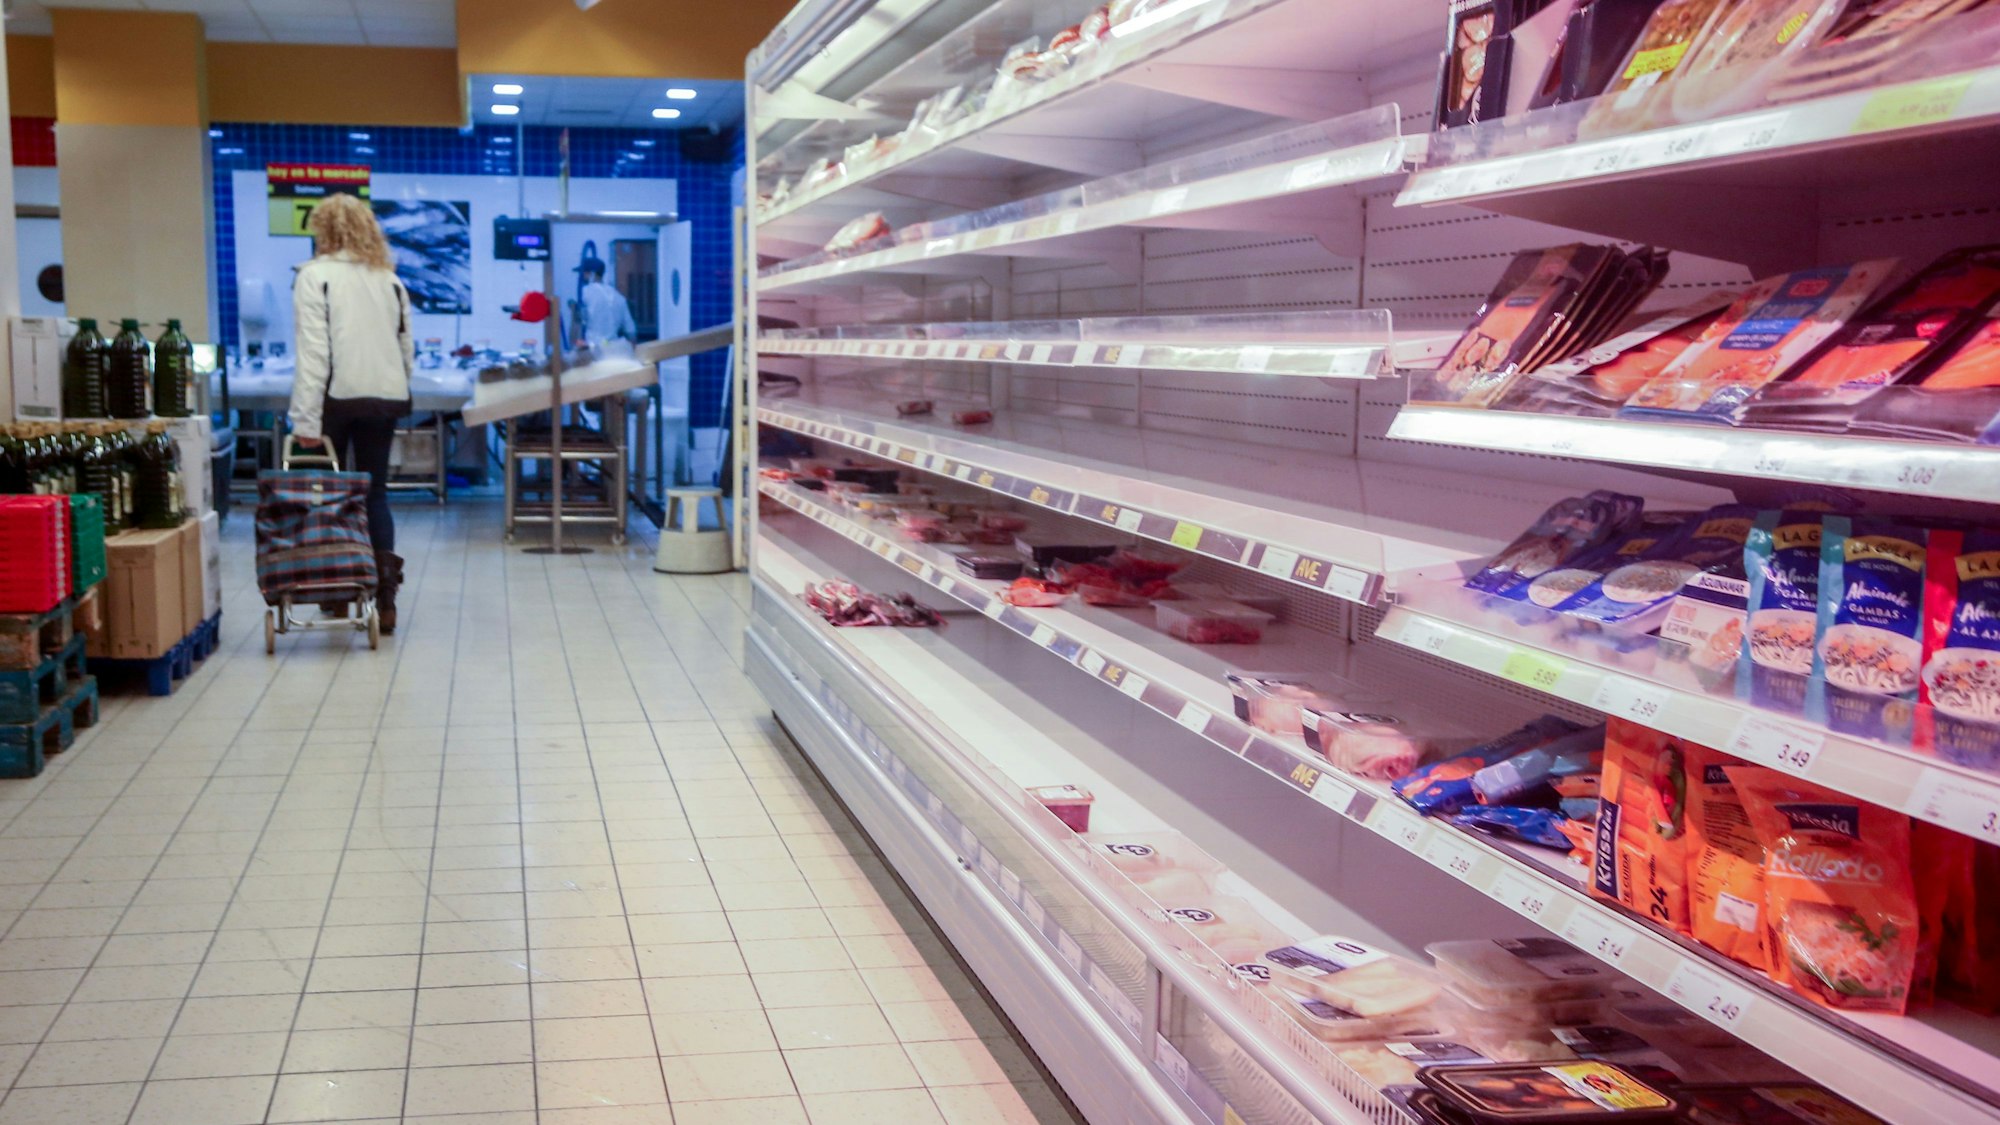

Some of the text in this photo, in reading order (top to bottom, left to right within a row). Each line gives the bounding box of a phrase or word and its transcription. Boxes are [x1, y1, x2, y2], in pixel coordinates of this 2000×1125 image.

[1897, 465, 1936, 485] 3.08
[1782, 530, 1820, 542] LA G
[1852, 543, 1871, 554] LA
[1295, 558, 1322, 581] AVE
[1967, 560, 1990, 573] LA
[1848, 602, 1900, 620] GAMBAS
[1960, 626, 1978, 638] AL
[1777, 743, 1810, 768] 3.49
[1290, 763, 1319, 788] AVE
[1598, 807, 1612, 888] Krissia
[1622, 852, 1631, 888] CUIDA
[1770, 848, 1884, 882] Rallado
[1650, 887, 1670, 921] 24
[1708, 996, 1740, 1020] 2.49
